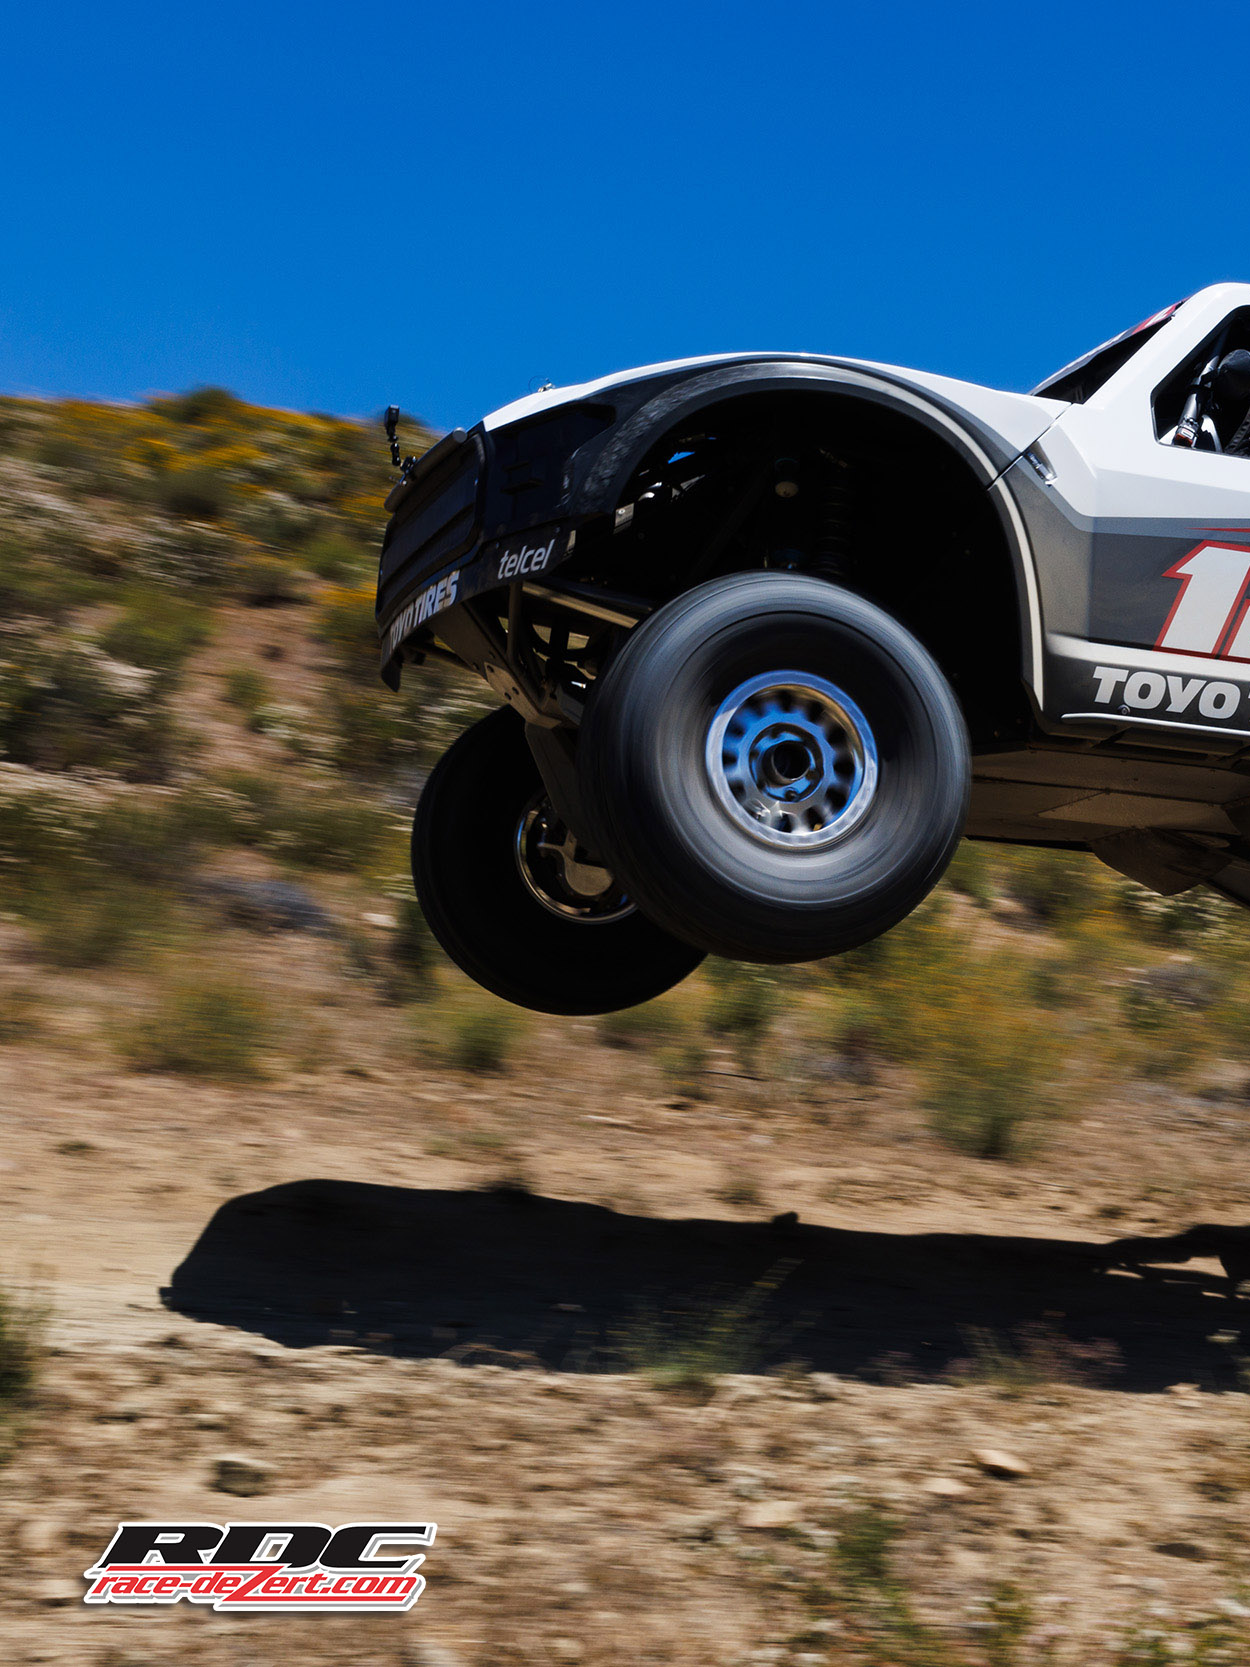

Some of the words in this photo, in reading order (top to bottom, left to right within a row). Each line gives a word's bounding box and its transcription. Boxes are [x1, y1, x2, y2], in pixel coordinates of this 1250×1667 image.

[498, 539, 554, 580] telcel
[413, 570, 460, 628] TIRES
[1092, 665, 1241, 719] TOYO
